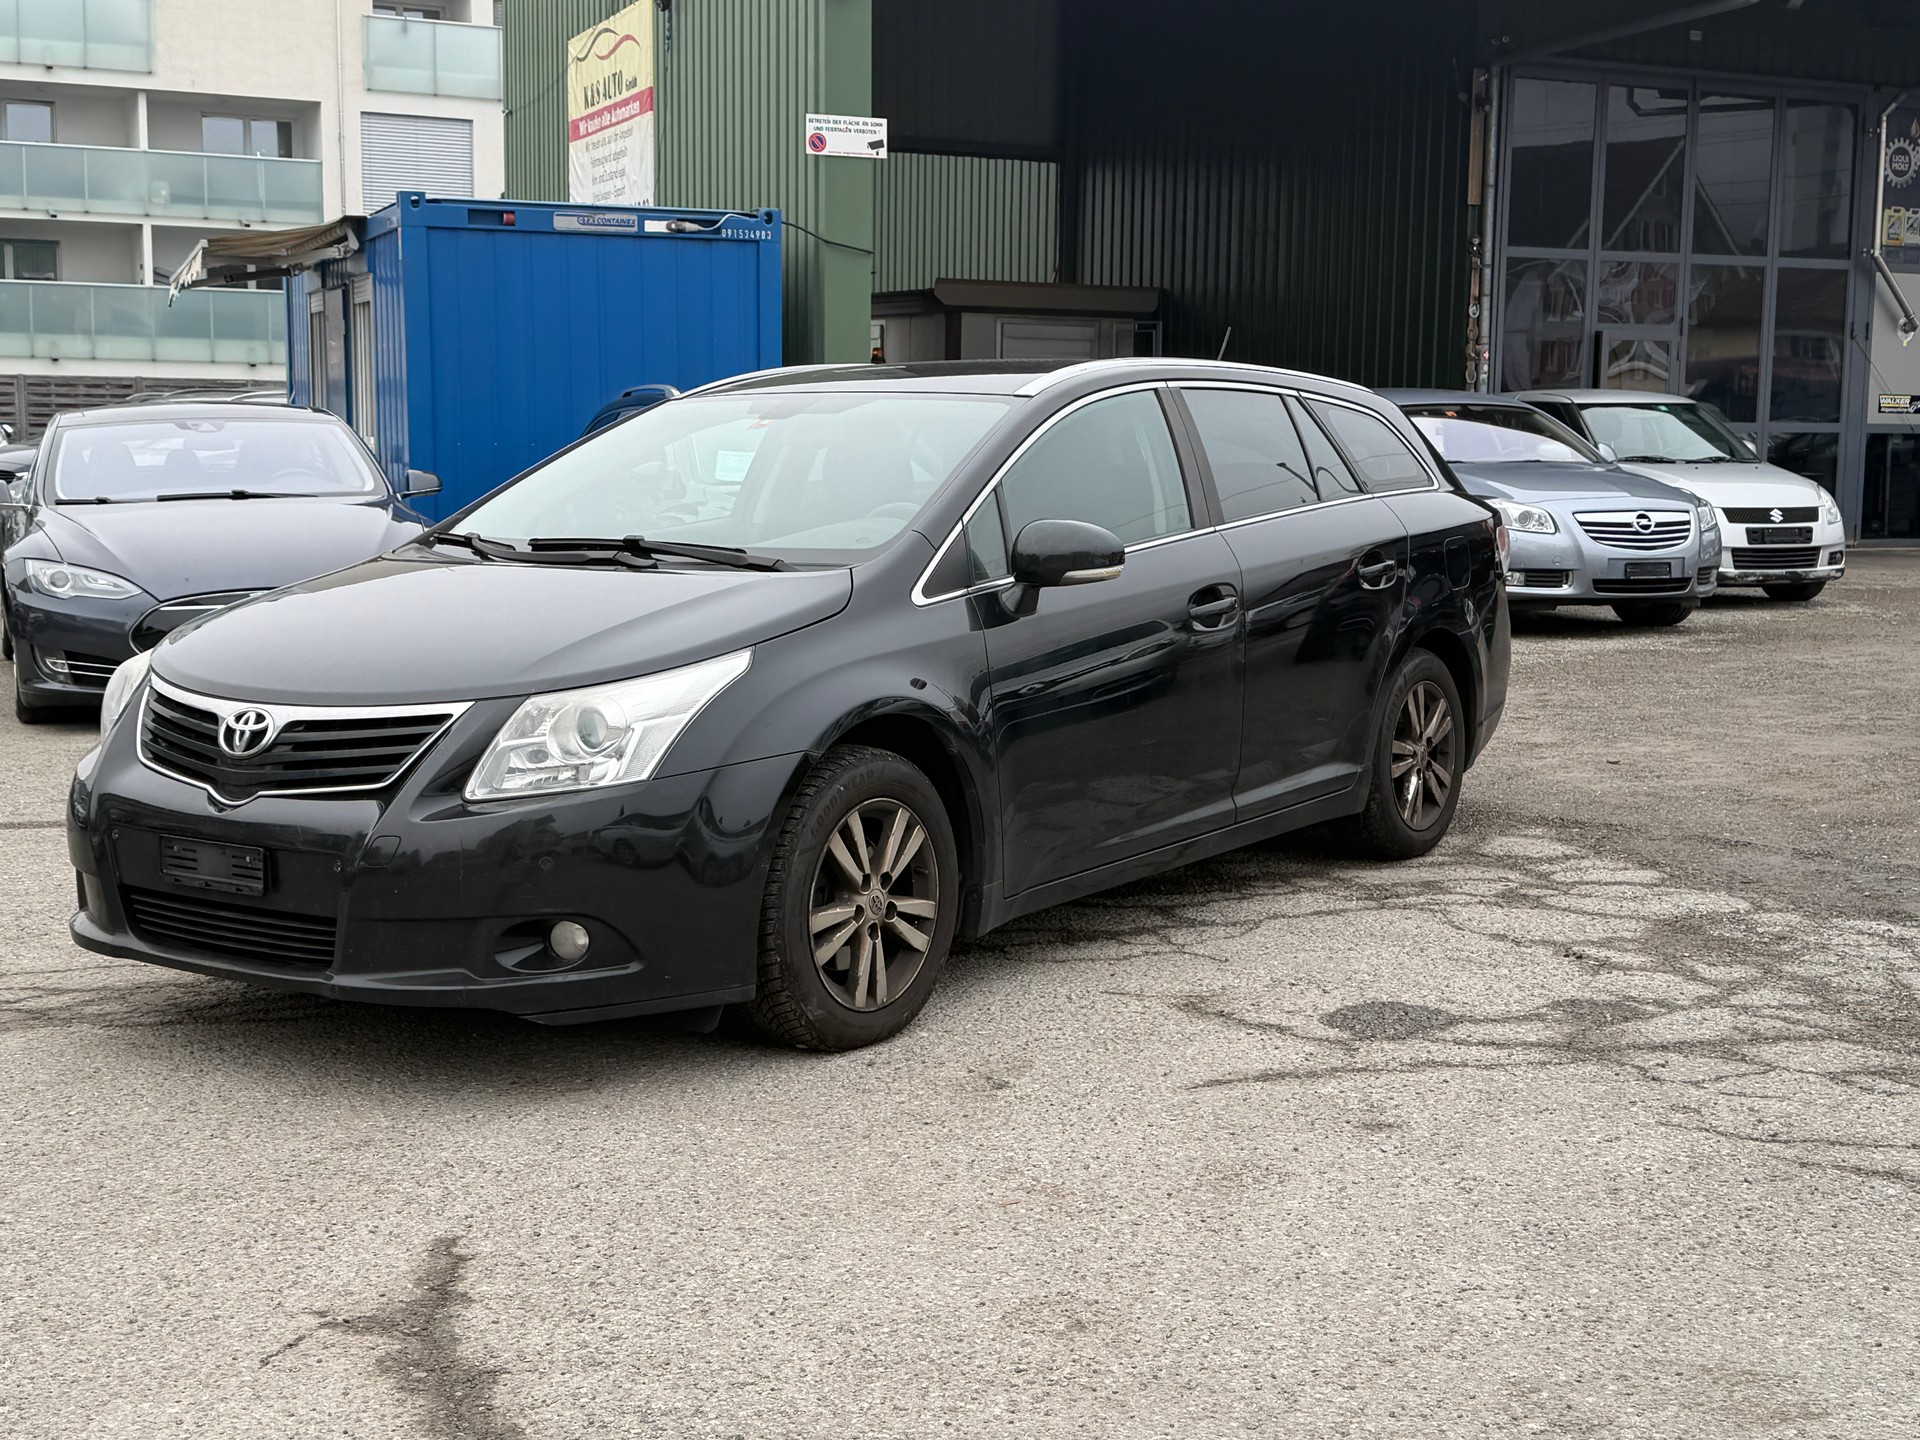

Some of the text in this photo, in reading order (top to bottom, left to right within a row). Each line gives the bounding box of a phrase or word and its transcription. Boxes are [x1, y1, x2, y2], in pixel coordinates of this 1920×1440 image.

[583, 80, 600, 110] K&S
[602, 69, 623, 101] AUTO
[853, 127, 877, 135] VERBOTEN
[1892, 154, 1910, 163] LIQUI
[1891, 162, 1910, 171] MOLY
[596, 217, 635, 226] CONTAINEX
